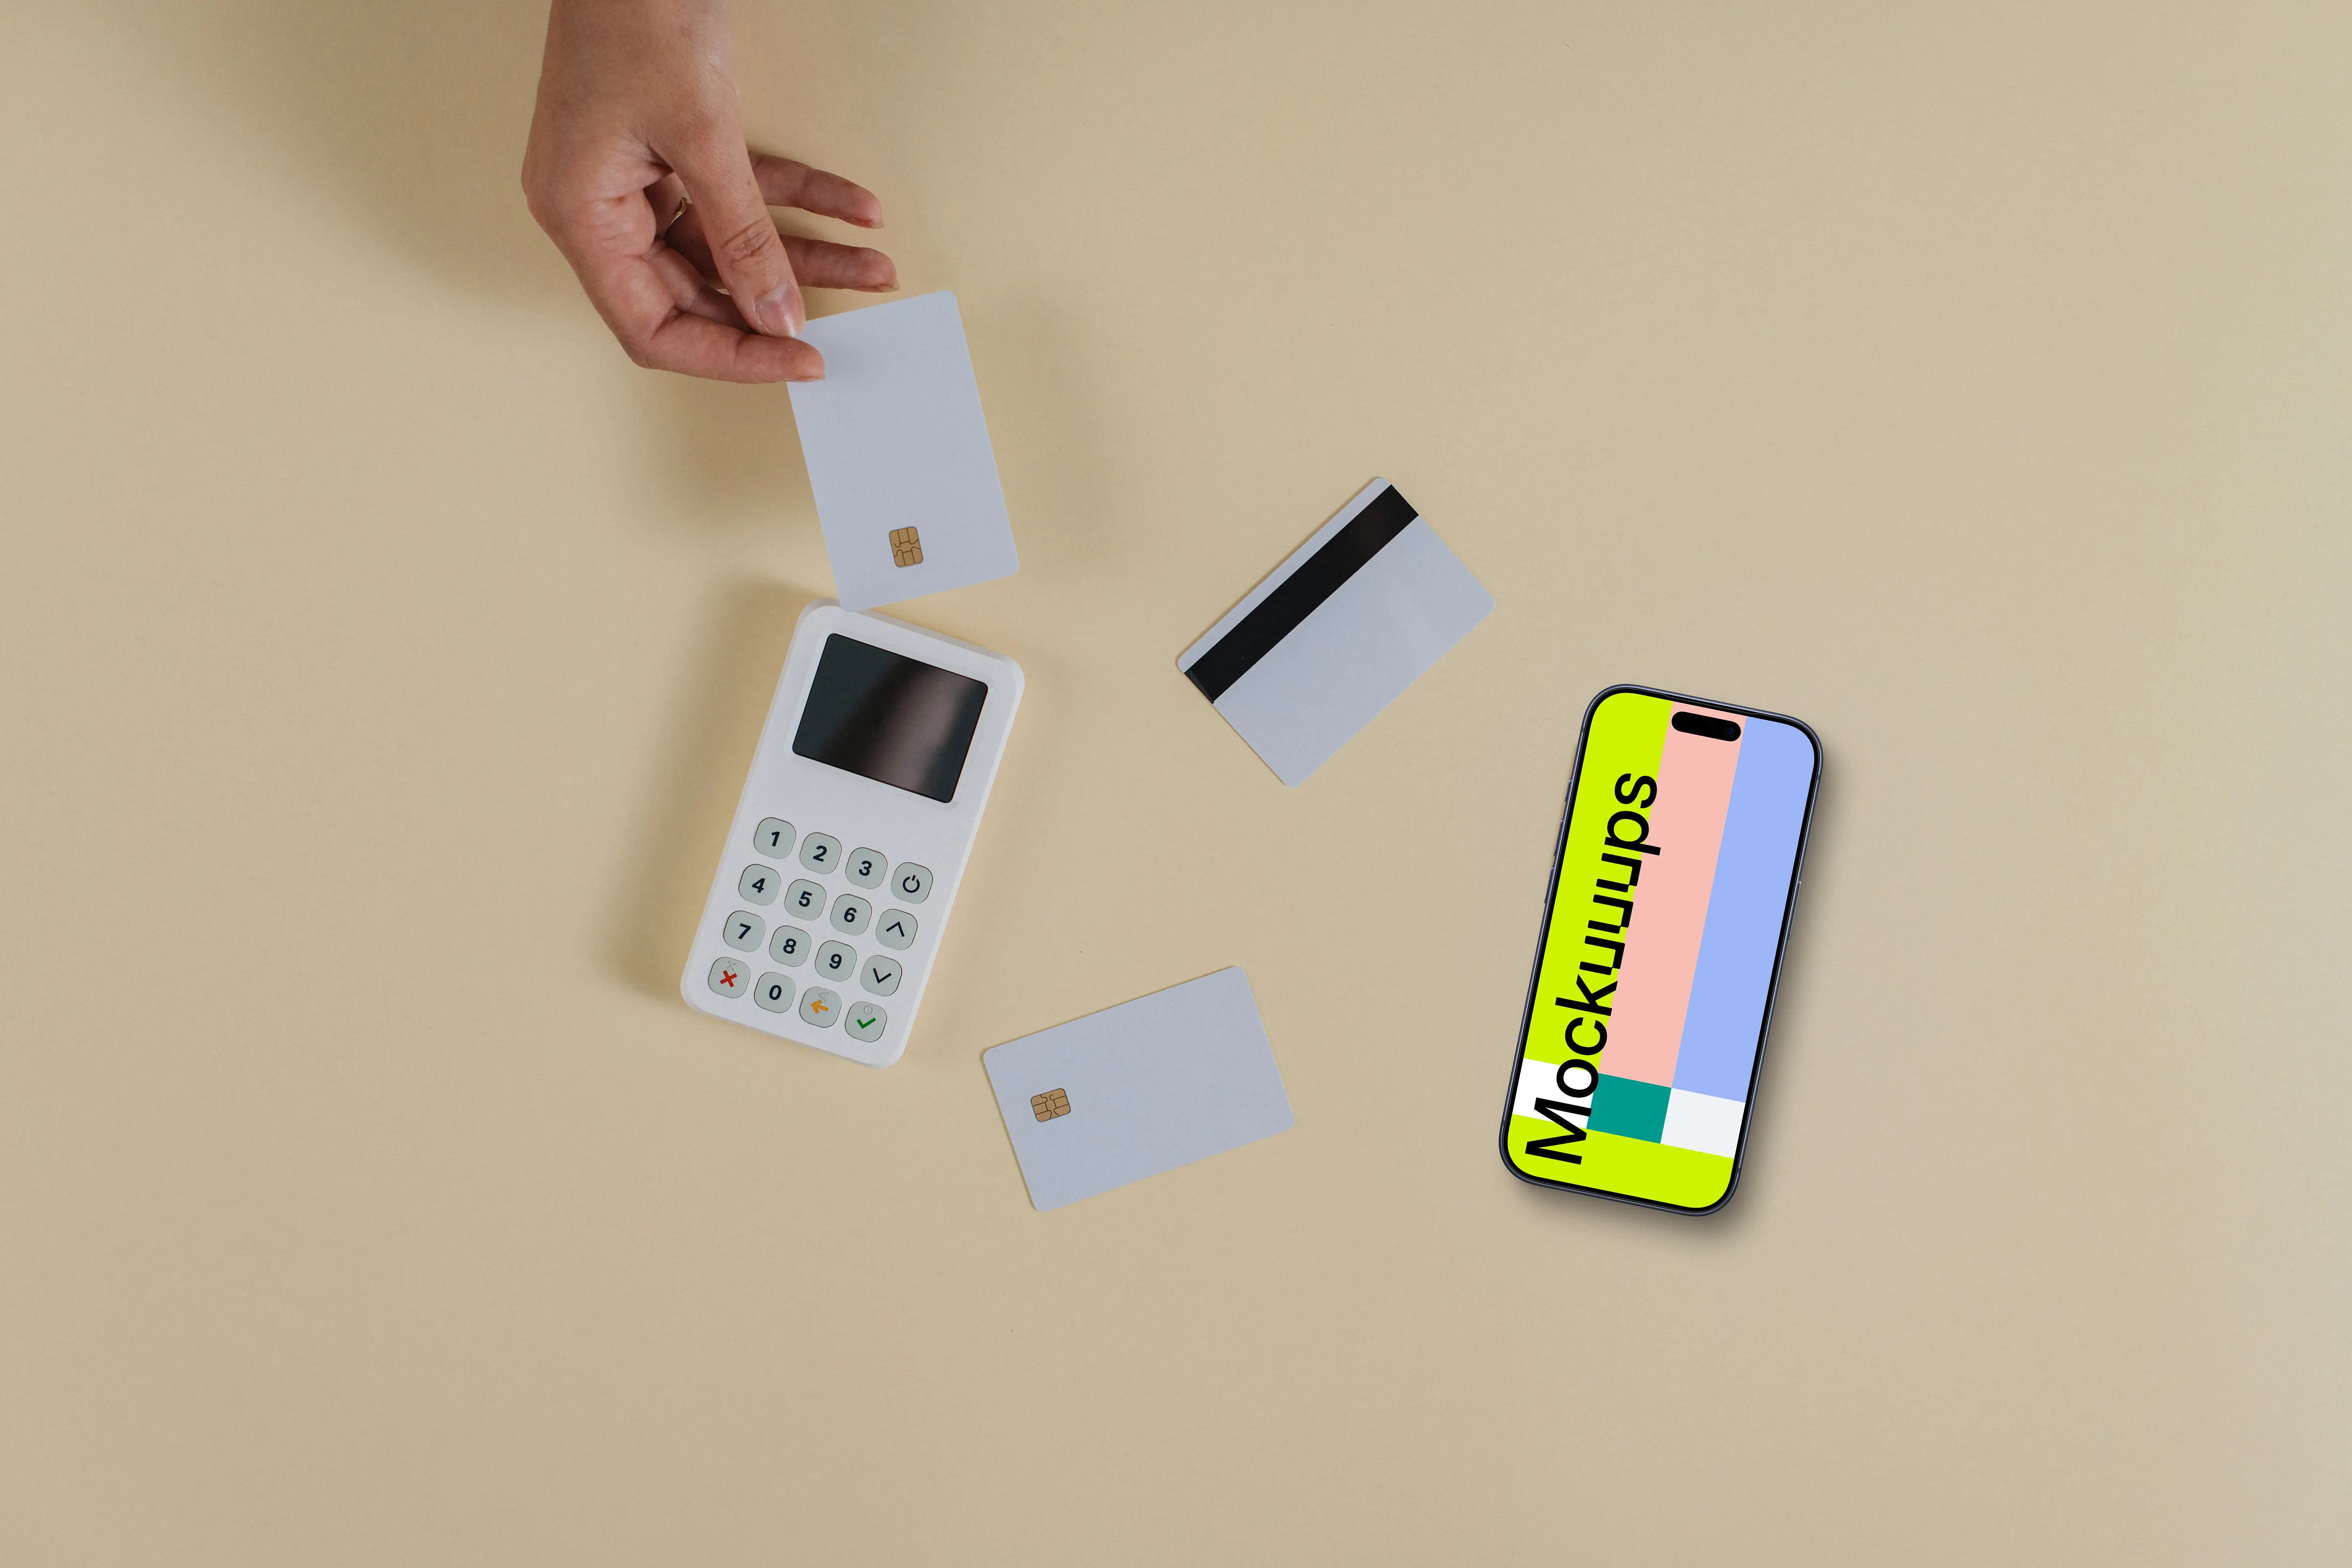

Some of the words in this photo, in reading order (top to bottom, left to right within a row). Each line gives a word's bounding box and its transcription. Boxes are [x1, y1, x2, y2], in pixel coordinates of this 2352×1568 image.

[771, 831, 780, 846] 1
[813, 845, 827, 862] 2
[859, 860, 872, 876] 3
[752, 878, 765, 893] 4
[799, 891, 812, 907] 5
[844, 907, 857, 922] 6
[738, 923, 751, 939] 7
[783, 939, 796, 954] 8
[829, 954, 842, 969] 9
[1525, 773, 1661, 1164] Mockuuups
[769, 985, 782, 1000] 0
